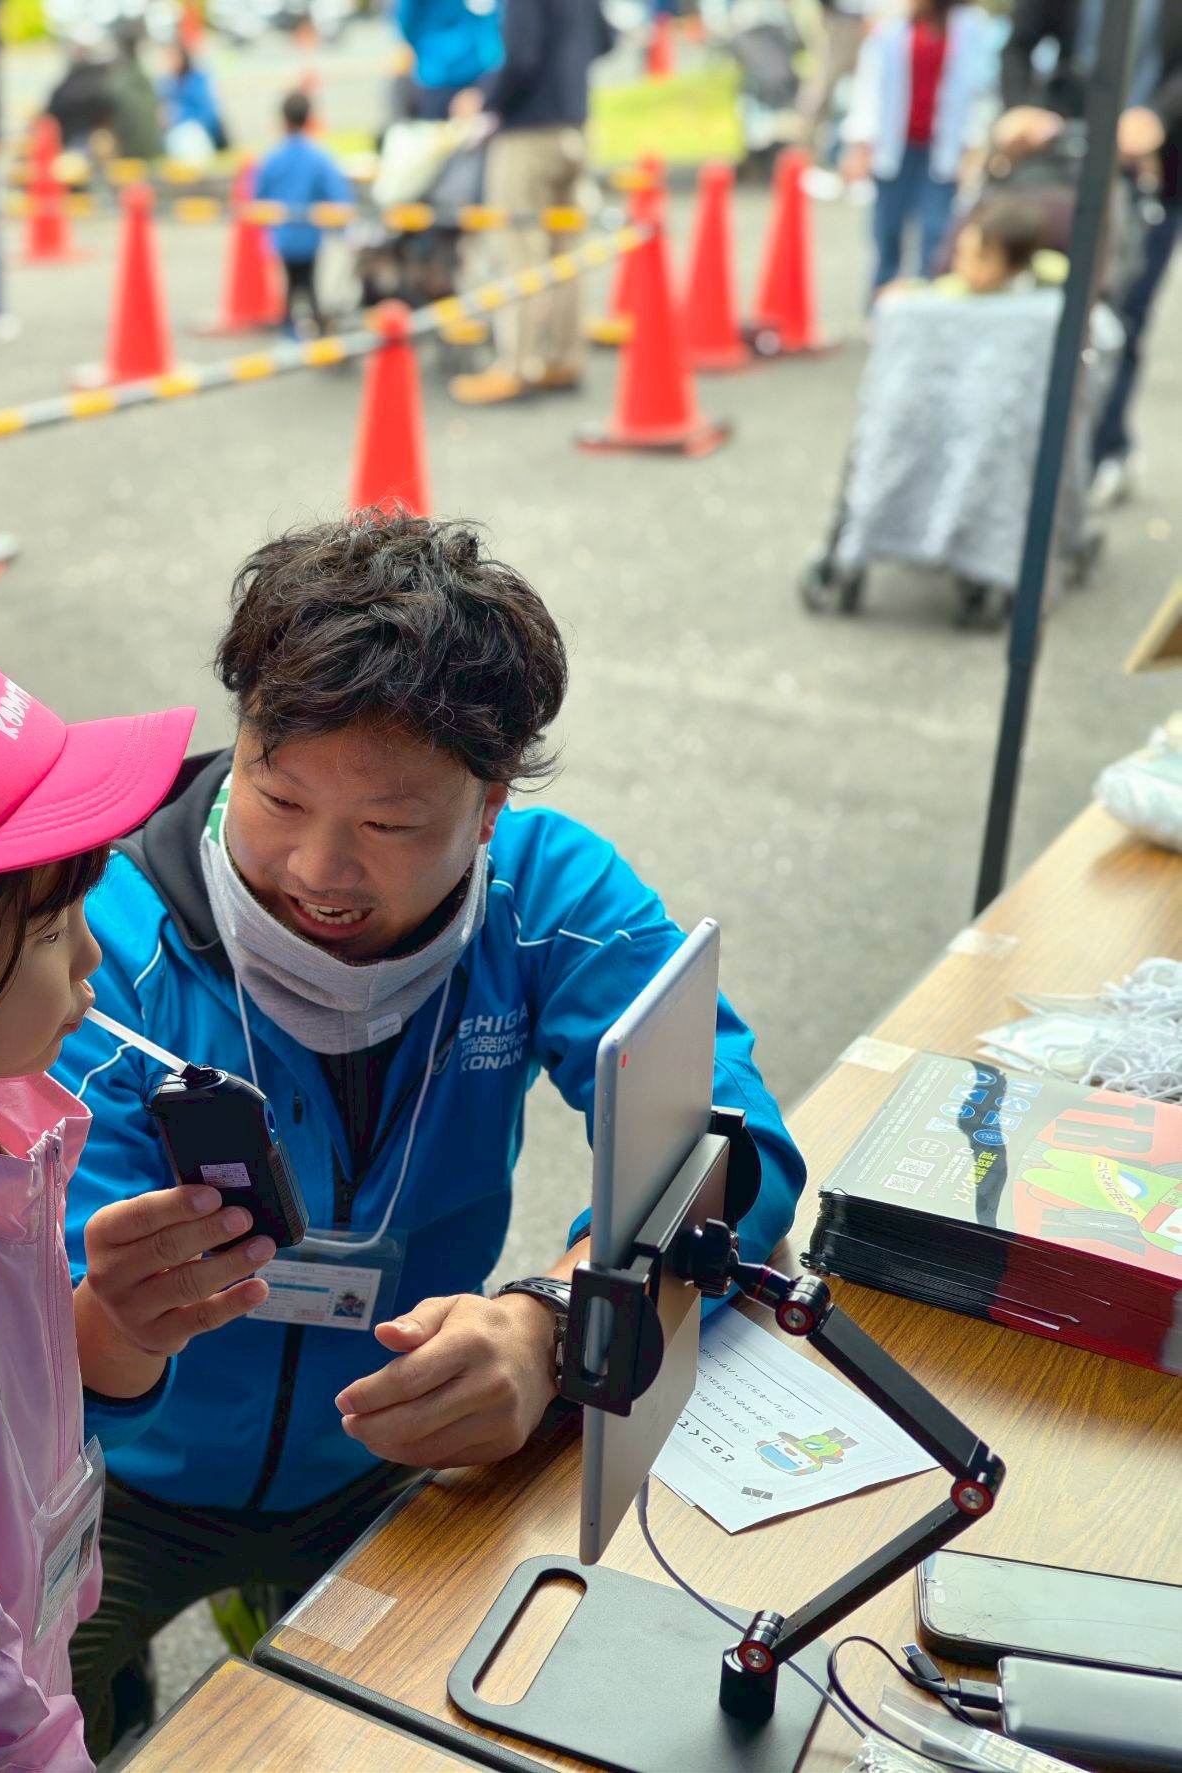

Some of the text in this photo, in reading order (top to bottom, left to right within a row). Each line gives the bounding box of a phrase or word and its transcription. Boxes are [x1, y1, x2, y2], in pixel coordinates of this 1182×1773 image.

[458, 1002, 528, 1039] SHIGA
[459, 1046, 523, 1075] KONAN
[1040, 1100, 1155, 1256] TRK
[697, 1346, 797, 1420] ③ブレーキランプ・ハザードは
[697, 1366, 774, 1427] ②タイヤのくうきはいっ
[694, 1390, 750, 1435] ①ライトはきちん
[676, 1416, 735, 1463] とらっくて
